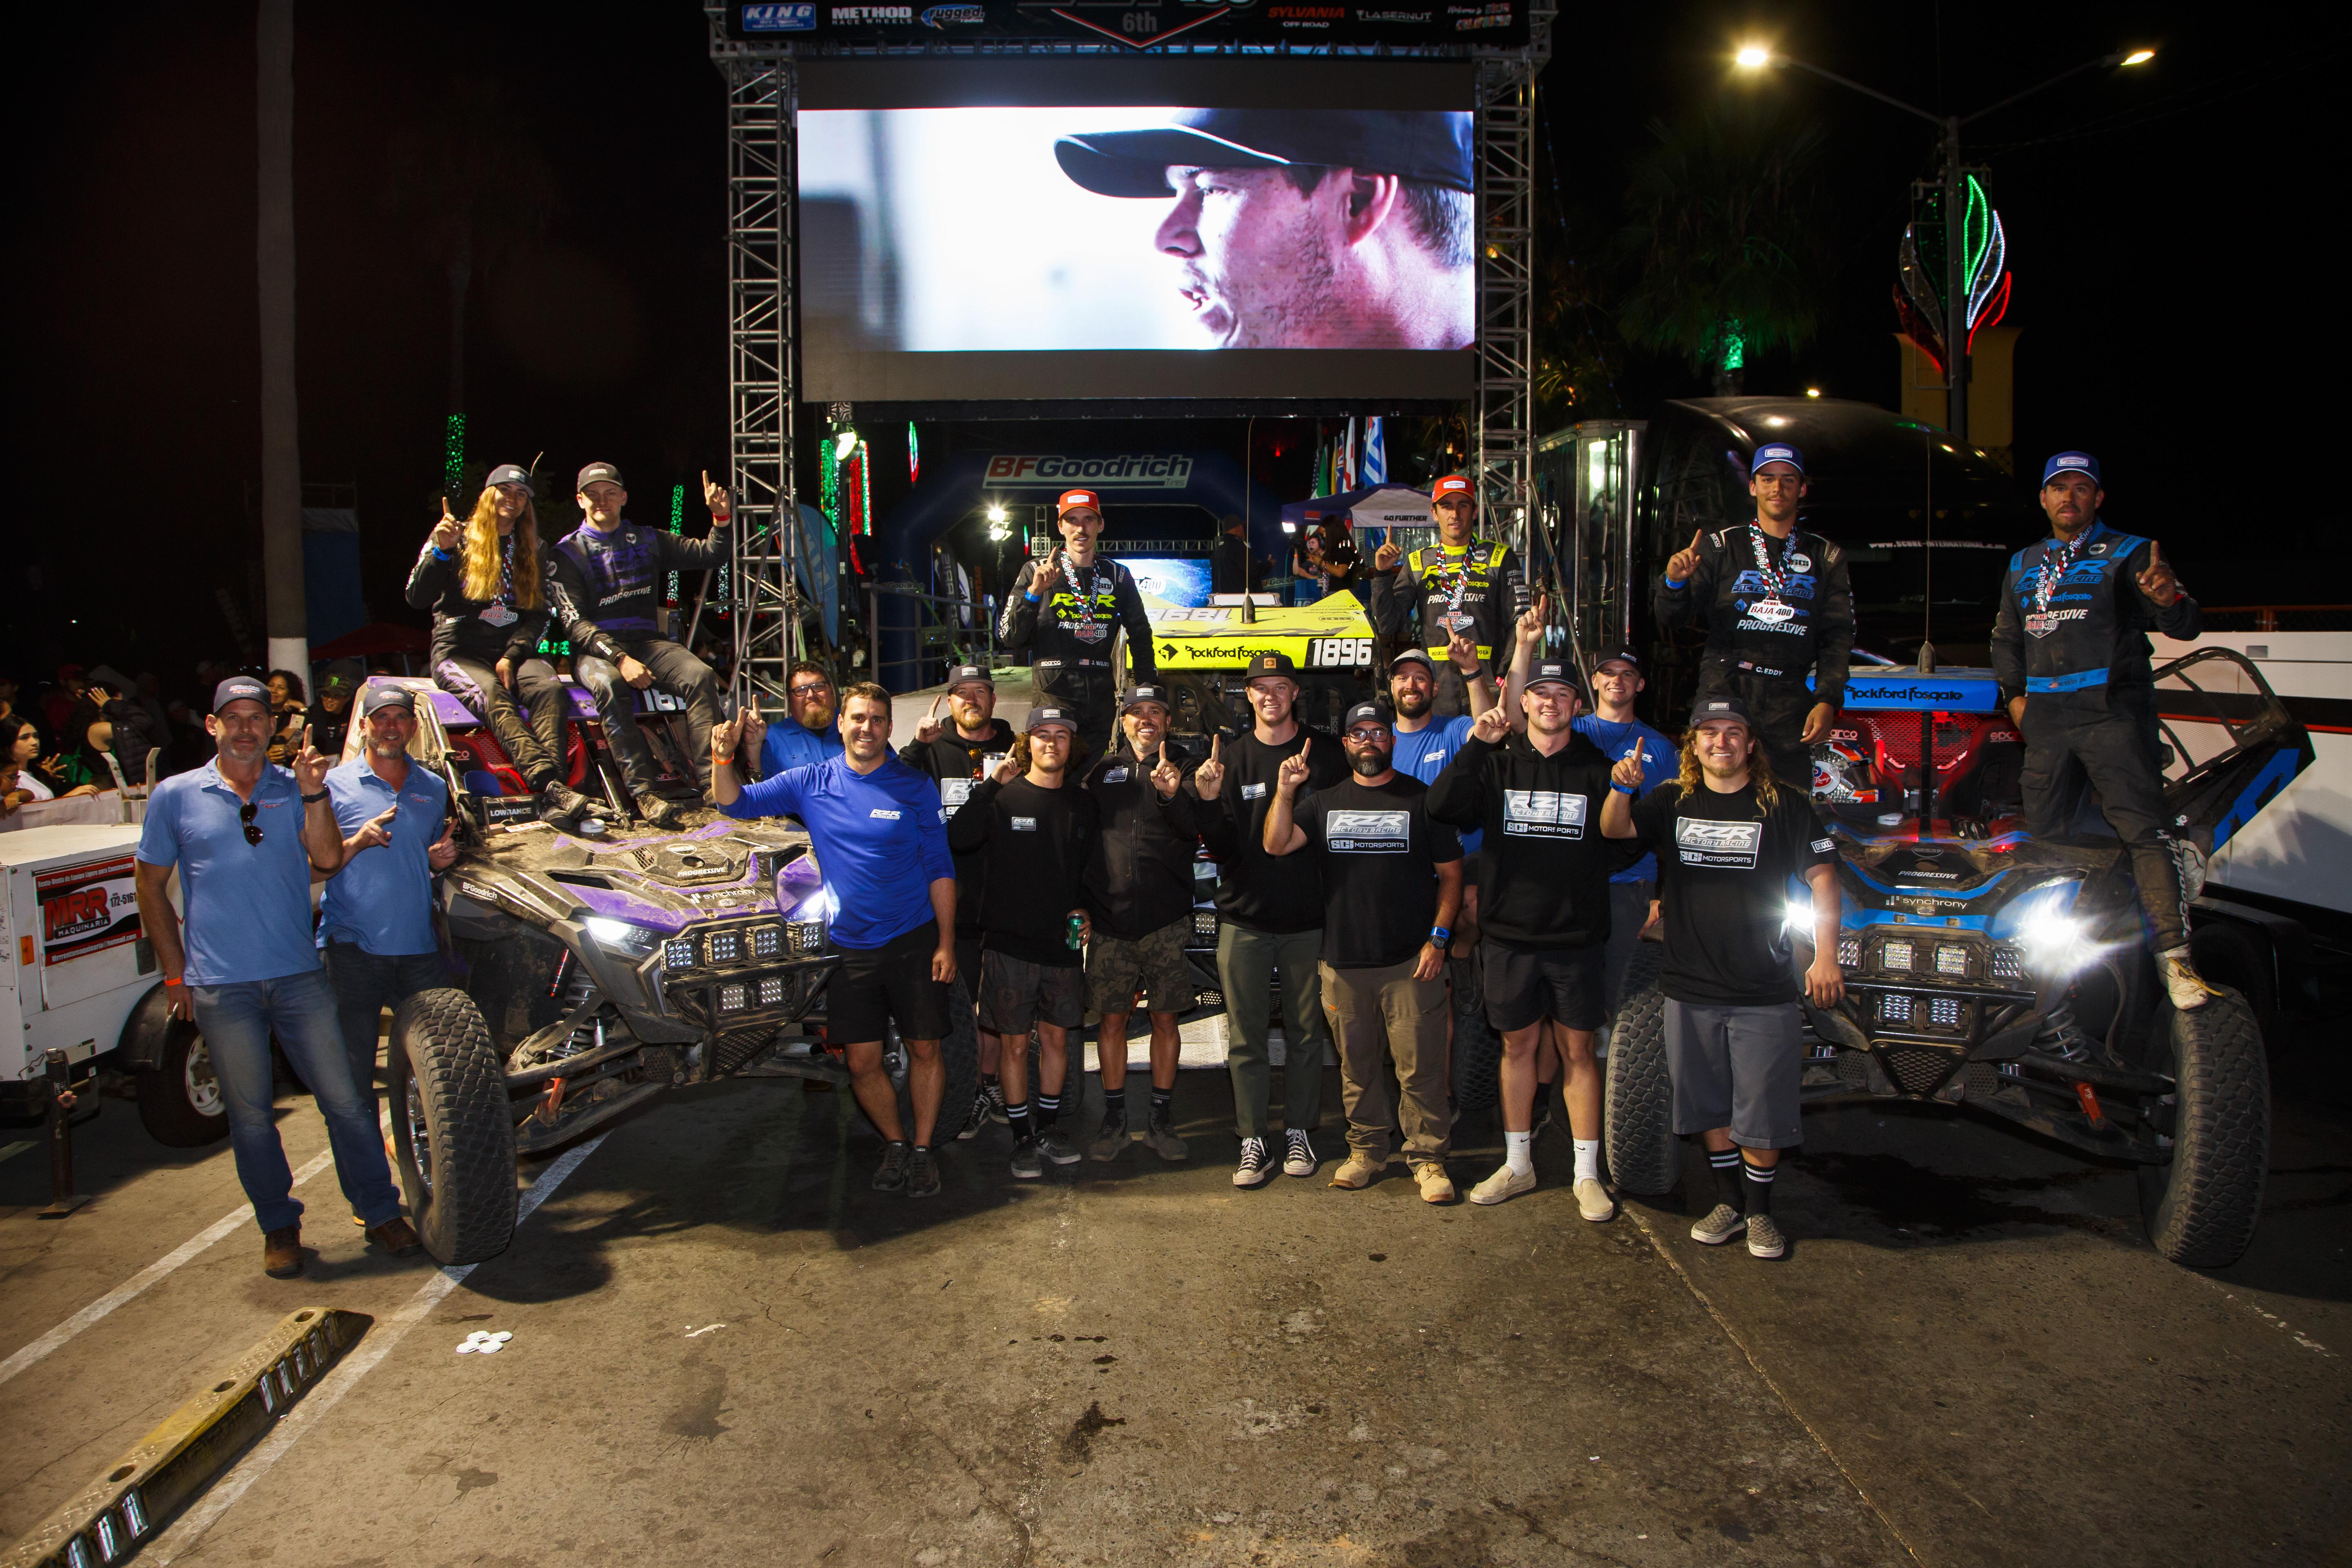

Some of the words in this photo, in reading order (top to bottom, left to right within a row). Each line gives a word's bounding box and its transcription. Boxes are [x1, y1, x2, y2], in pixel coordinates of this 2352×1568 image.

[746, 5, 812, 18] KING
[832, 6, 912, 19] METHOD
[1268, 7, 1345, 18] SYLVANIA
[1365, 11, 1432, 21] LASERNUT
[1123, 12, 1157, 32] 6th
[988, 454, 1190, 478] BFGoodrich
[1754, 538, 1768, 568] FINISHER
[1062, 560, 1078, 588] FINISHER
[2060, 574, 2103, 584] RACING
[1090, 576, 1100, 604] FINISHER
[2037, 569, 2047, 602] FINISHER
[1780, 587, 1815, 599] RACING
[2061, 591, 2093, 603] Fosgate
[1750, 606, 1773, 615] BAJA
[1776, 608, 1791, 616] 400
[2026, 621, 2042, 629] BAJA
[2044, 621, 2057, 629] 400
[1185, 646, 1236, 660] Rockford
[1312, 638, 1372, 666] 1896
[1764, 668, 1783, 676] EDDY
[1845, 686, 1907, 700] Rockford
[1909, 687, 1963, 702] Fosgate
[1830, 729, 1858, 739] arco
[1509, 795, 1582, 812] RZR
[490, 808, 532, 817] LOWRANCE
[870, 809, 901, 817] RZR
[1545, 811, 1579, 820] RACING
[1335, 814, 1405, 827] RZR
[1528, 825, 1579, 835] MOTORSPORTS
[1684, 823, 1753, 840] RZR
[1680, 837, 1718, 847] FACTORY
[1719, 839, 1751, 848] RACING
[677, 867, 726, 877] PROGRESSIVE
[1898, 871, 1959, 879] PROGRESSIVE
[462, 882, 498, 900] BFGoodrich
[703, 888, 756, 900] synchrony
[1902, 897, 1969, 909] synchrony
[43, 886, 109, 941] MRR
